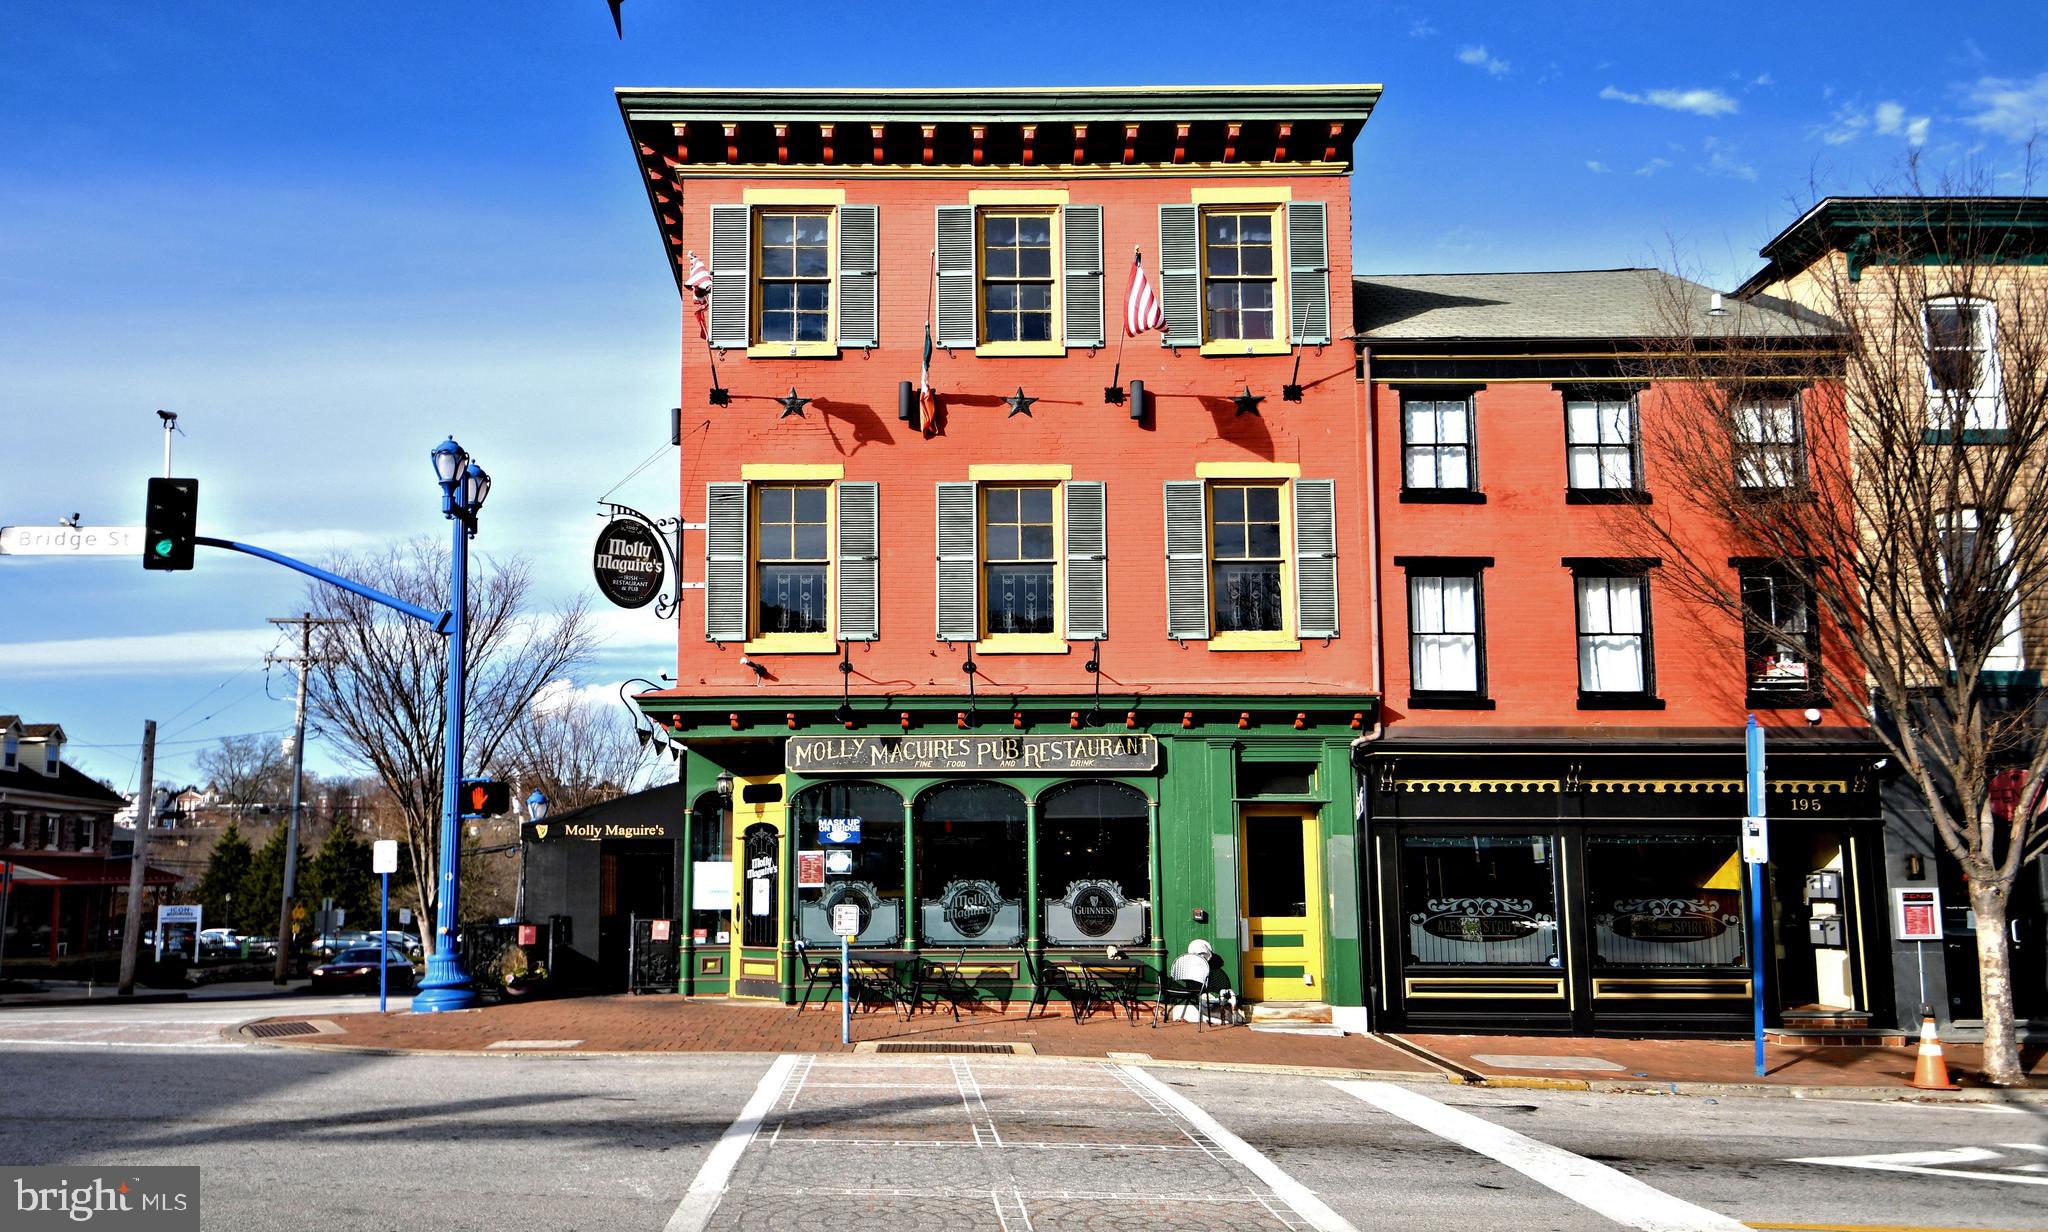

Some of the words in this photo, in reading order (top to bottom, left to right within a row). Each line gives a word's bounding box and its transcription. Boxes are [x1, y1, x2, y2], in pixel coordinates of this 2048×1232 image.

[19, 531, 97, 550] Bridge
[109, 531, 129, 546] St
[608, 538, 652, 560] Molly
[597, 554, 663, 573] Maguire's
[795, 739, 866, 766] MOLLY
[976, 739, 1019, 767] PUB
[1023, 738, 1150, 768] RESTAURANT
[914, 760, 933, 768] FINE
[946, 760, 967, 768] FOOD
[1791, 799, 1821, 811] 195
[818, 818, 846, 826] MASK
[847, 818, 860, 826] UP
[565, 824, 602, 838] Molly
[605, 824, 665, 838] Maguire's
[752, 856, 772, 869] Molly
[954, 893, 988, 908] Molly
[1074, 905, 1115, 915] GUINNESS
